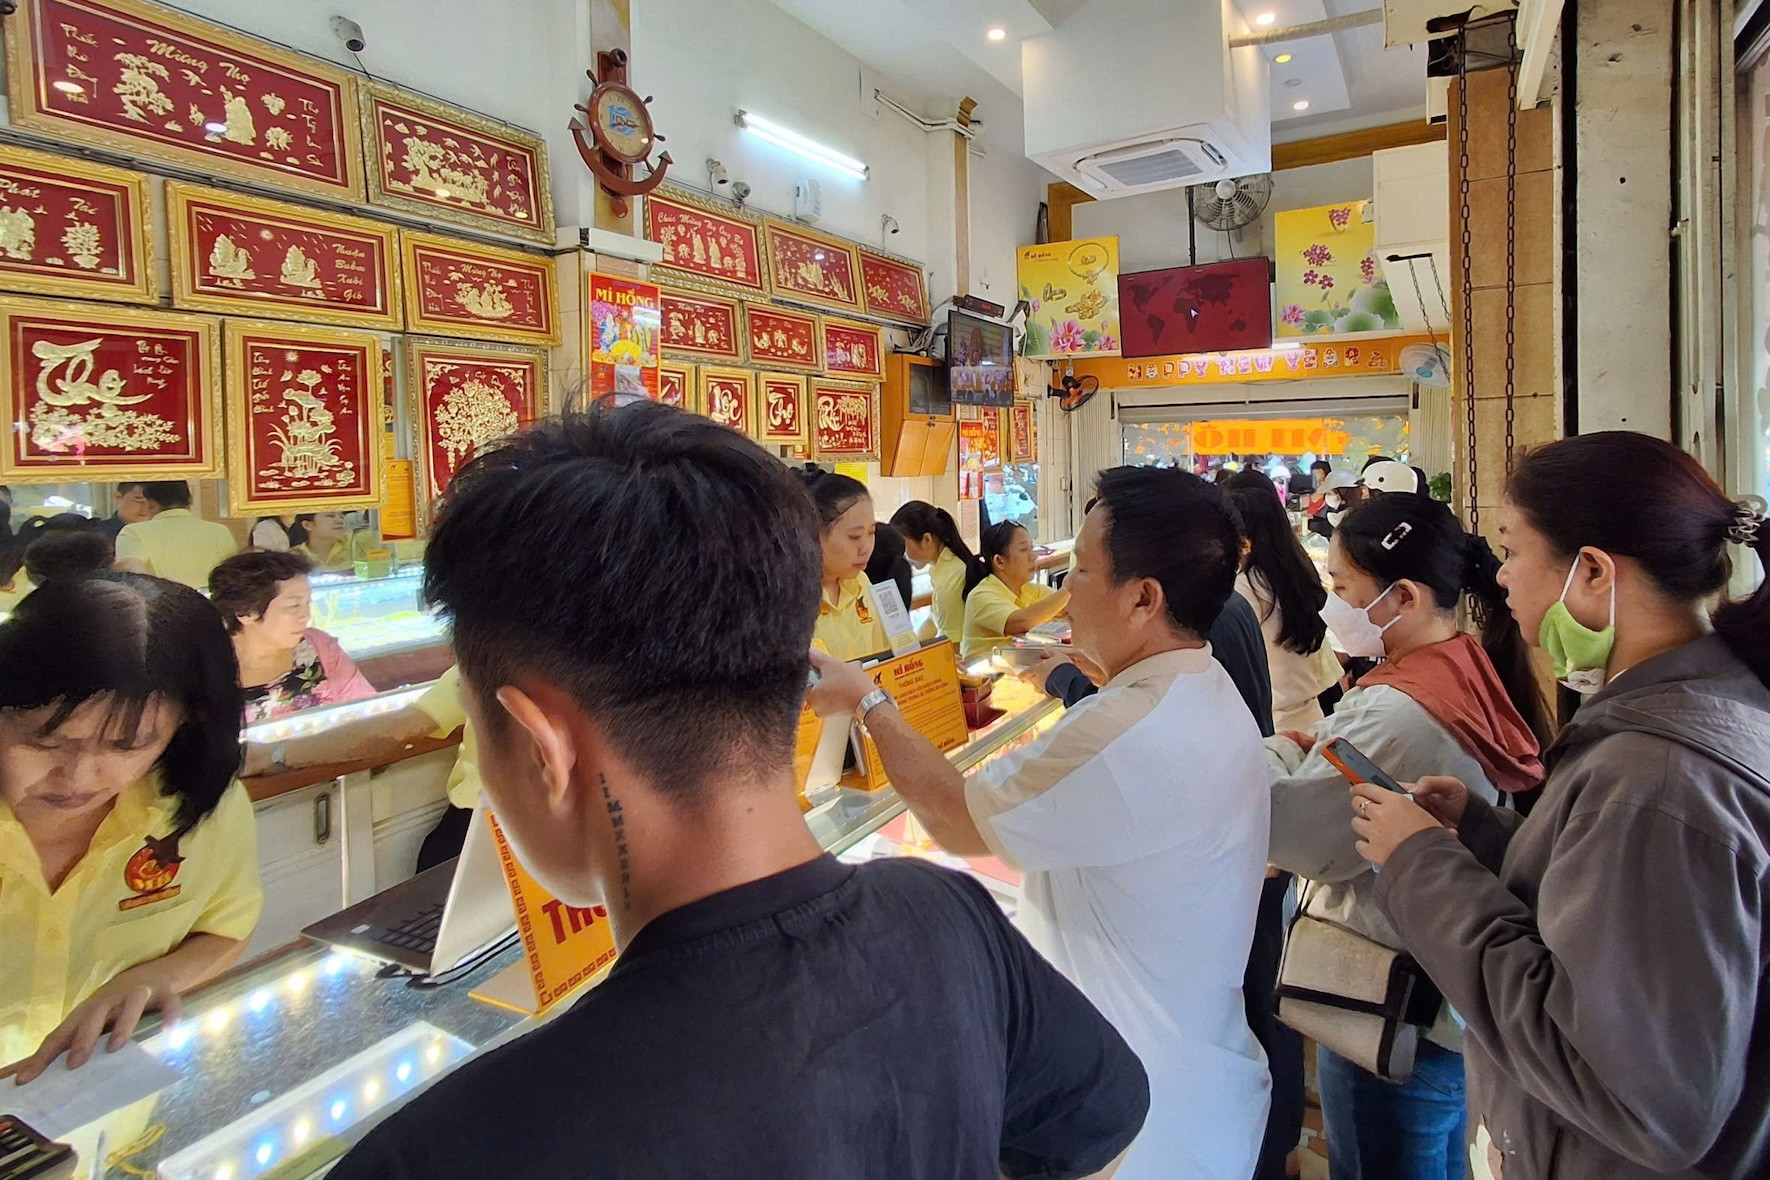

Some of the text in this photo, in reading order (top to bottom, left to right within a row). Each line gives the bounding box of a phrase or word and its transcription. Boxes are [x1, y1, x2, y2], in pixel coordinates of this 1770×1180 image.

[1128, 346, 1362, 381] HAPPY NEW YEAR
